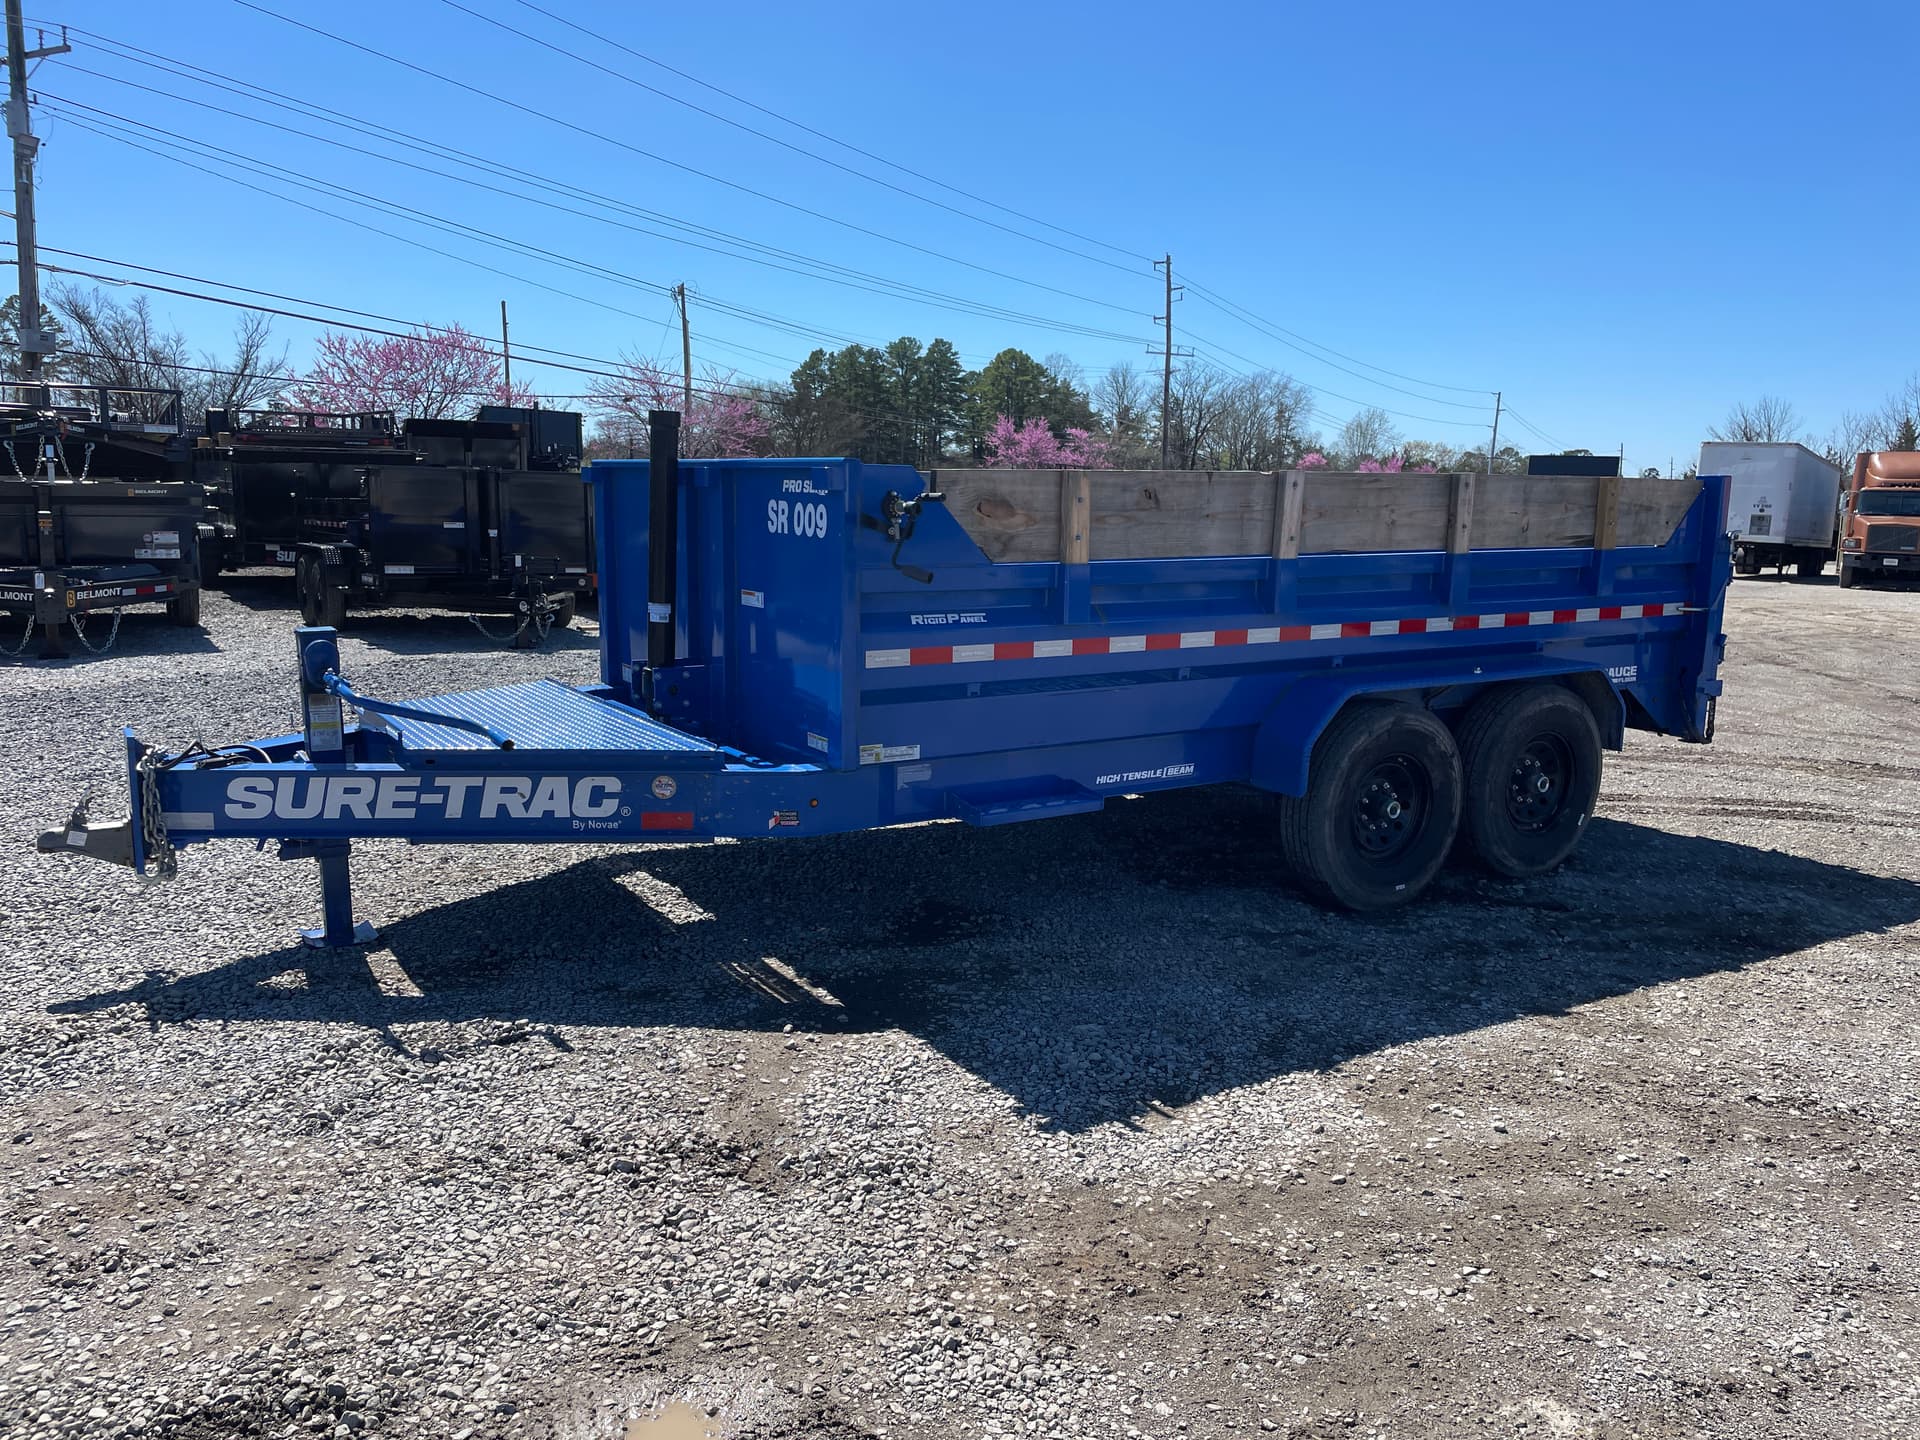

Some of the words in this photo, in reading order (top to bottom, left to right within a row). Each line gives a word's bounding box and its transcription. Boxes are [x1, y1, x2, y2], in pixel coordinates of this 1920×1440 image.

[783, 480, 802, 493] PRO
[767, 499, 789, 534] SR
[794, 502, 828, 539] 009
[77, 587, 122, 600] BELMONT
[1096, 774, 1121, 785] HIGH
[1122, 768, 1163, 782] TENSILE
[224, 776, 622, 819] SURE-TRAC
[572, 820, 586, 831] By
